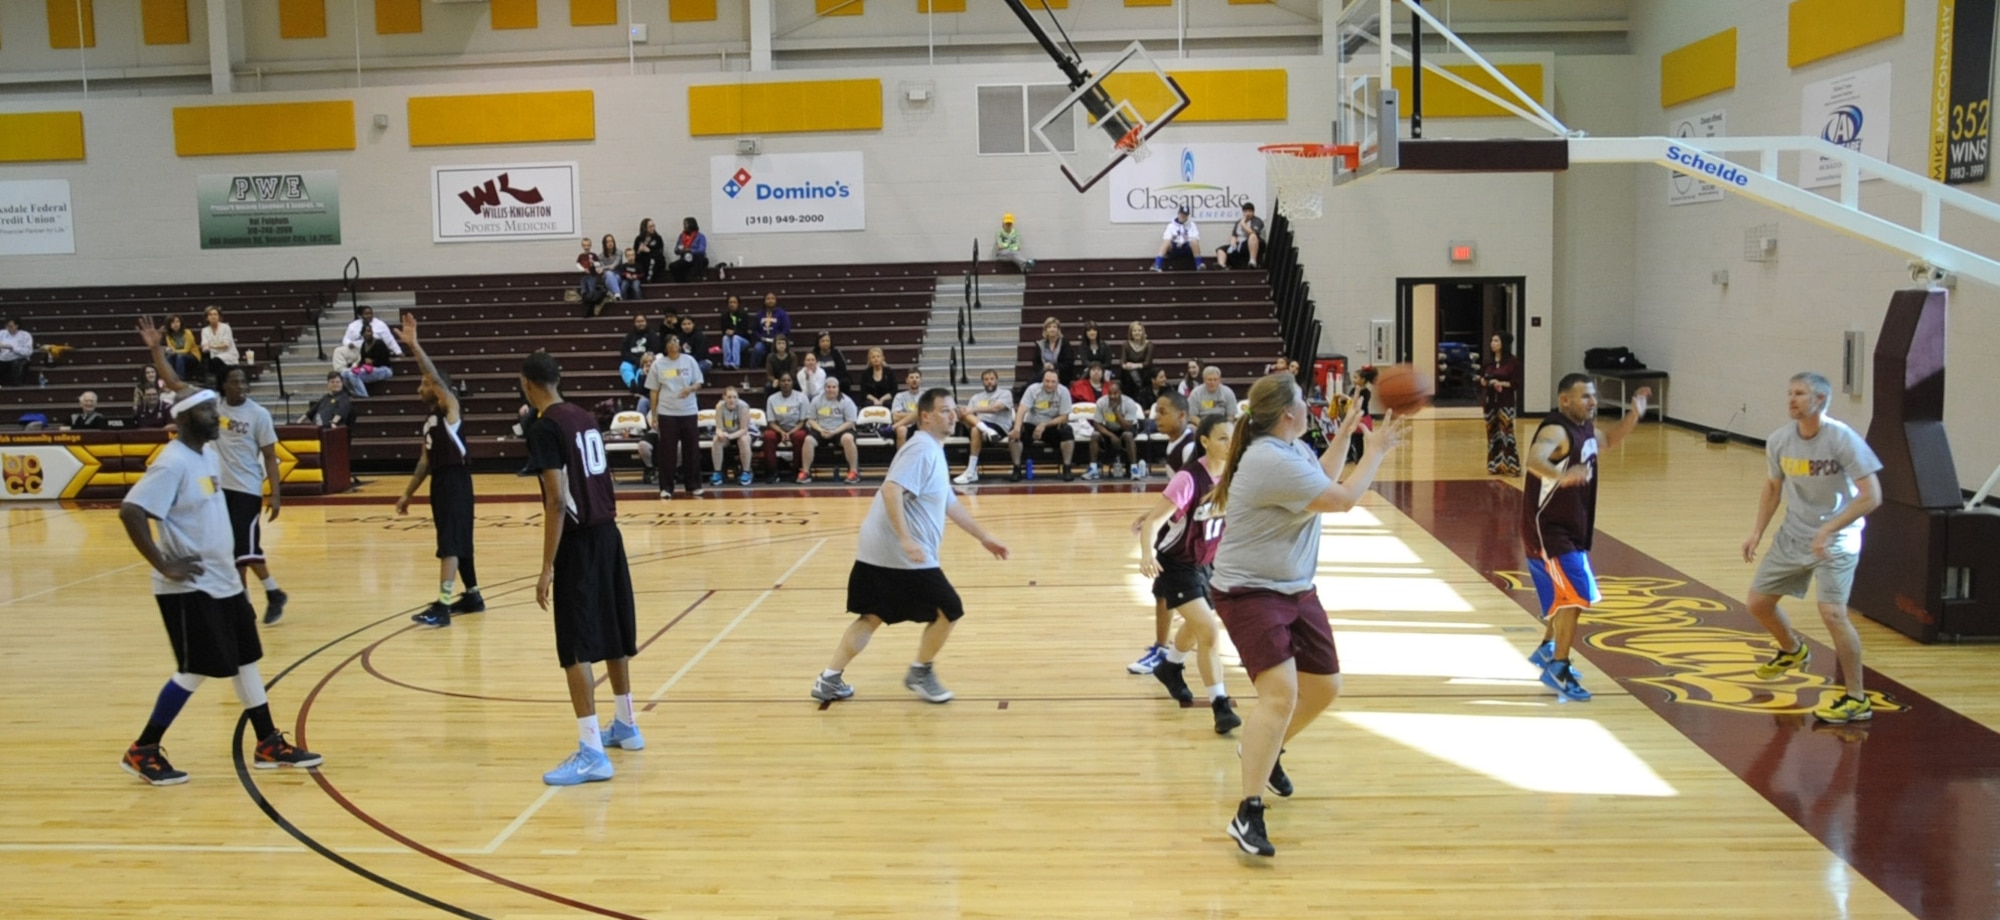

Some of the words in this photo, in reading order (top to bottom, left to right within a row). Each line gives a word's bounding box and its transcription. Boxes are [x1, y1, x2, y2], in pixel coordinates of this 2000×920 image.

[1936, 6, 1951, 133] MCCONATHY
[1951, 98, 1990, 140] 352
[1933, 134, 1944, 180] MIKE
[1950, 139, 1988, 163] WINS
[1666, 146, 1748, 186] Schelde
[1950, 167, 1966, 180] 1983
[1970, 164, 1984, 178] 1999
[235, 177, 301, 201] PWE
[756, 181, 849, 200] Domino's
[31, 203, 67, 212] Federal
[1127, 187, 1249, 218] Chesapeake
[1, 216, 23, 225] redit
[27, 215, 55, 224] Union
[745, 215, 772, 226] (318)
[775, 214, 824, 224] 949-2000
[1199, 210, 1240, 218] ENERGY
[464, 221, 500, 233] SPORTS
[504, 220, 557, 232] MEDICINE
[13, 433, 52, 443] community
[54, 433, 81, 442] college
[576, 428, 607, 478] 10
